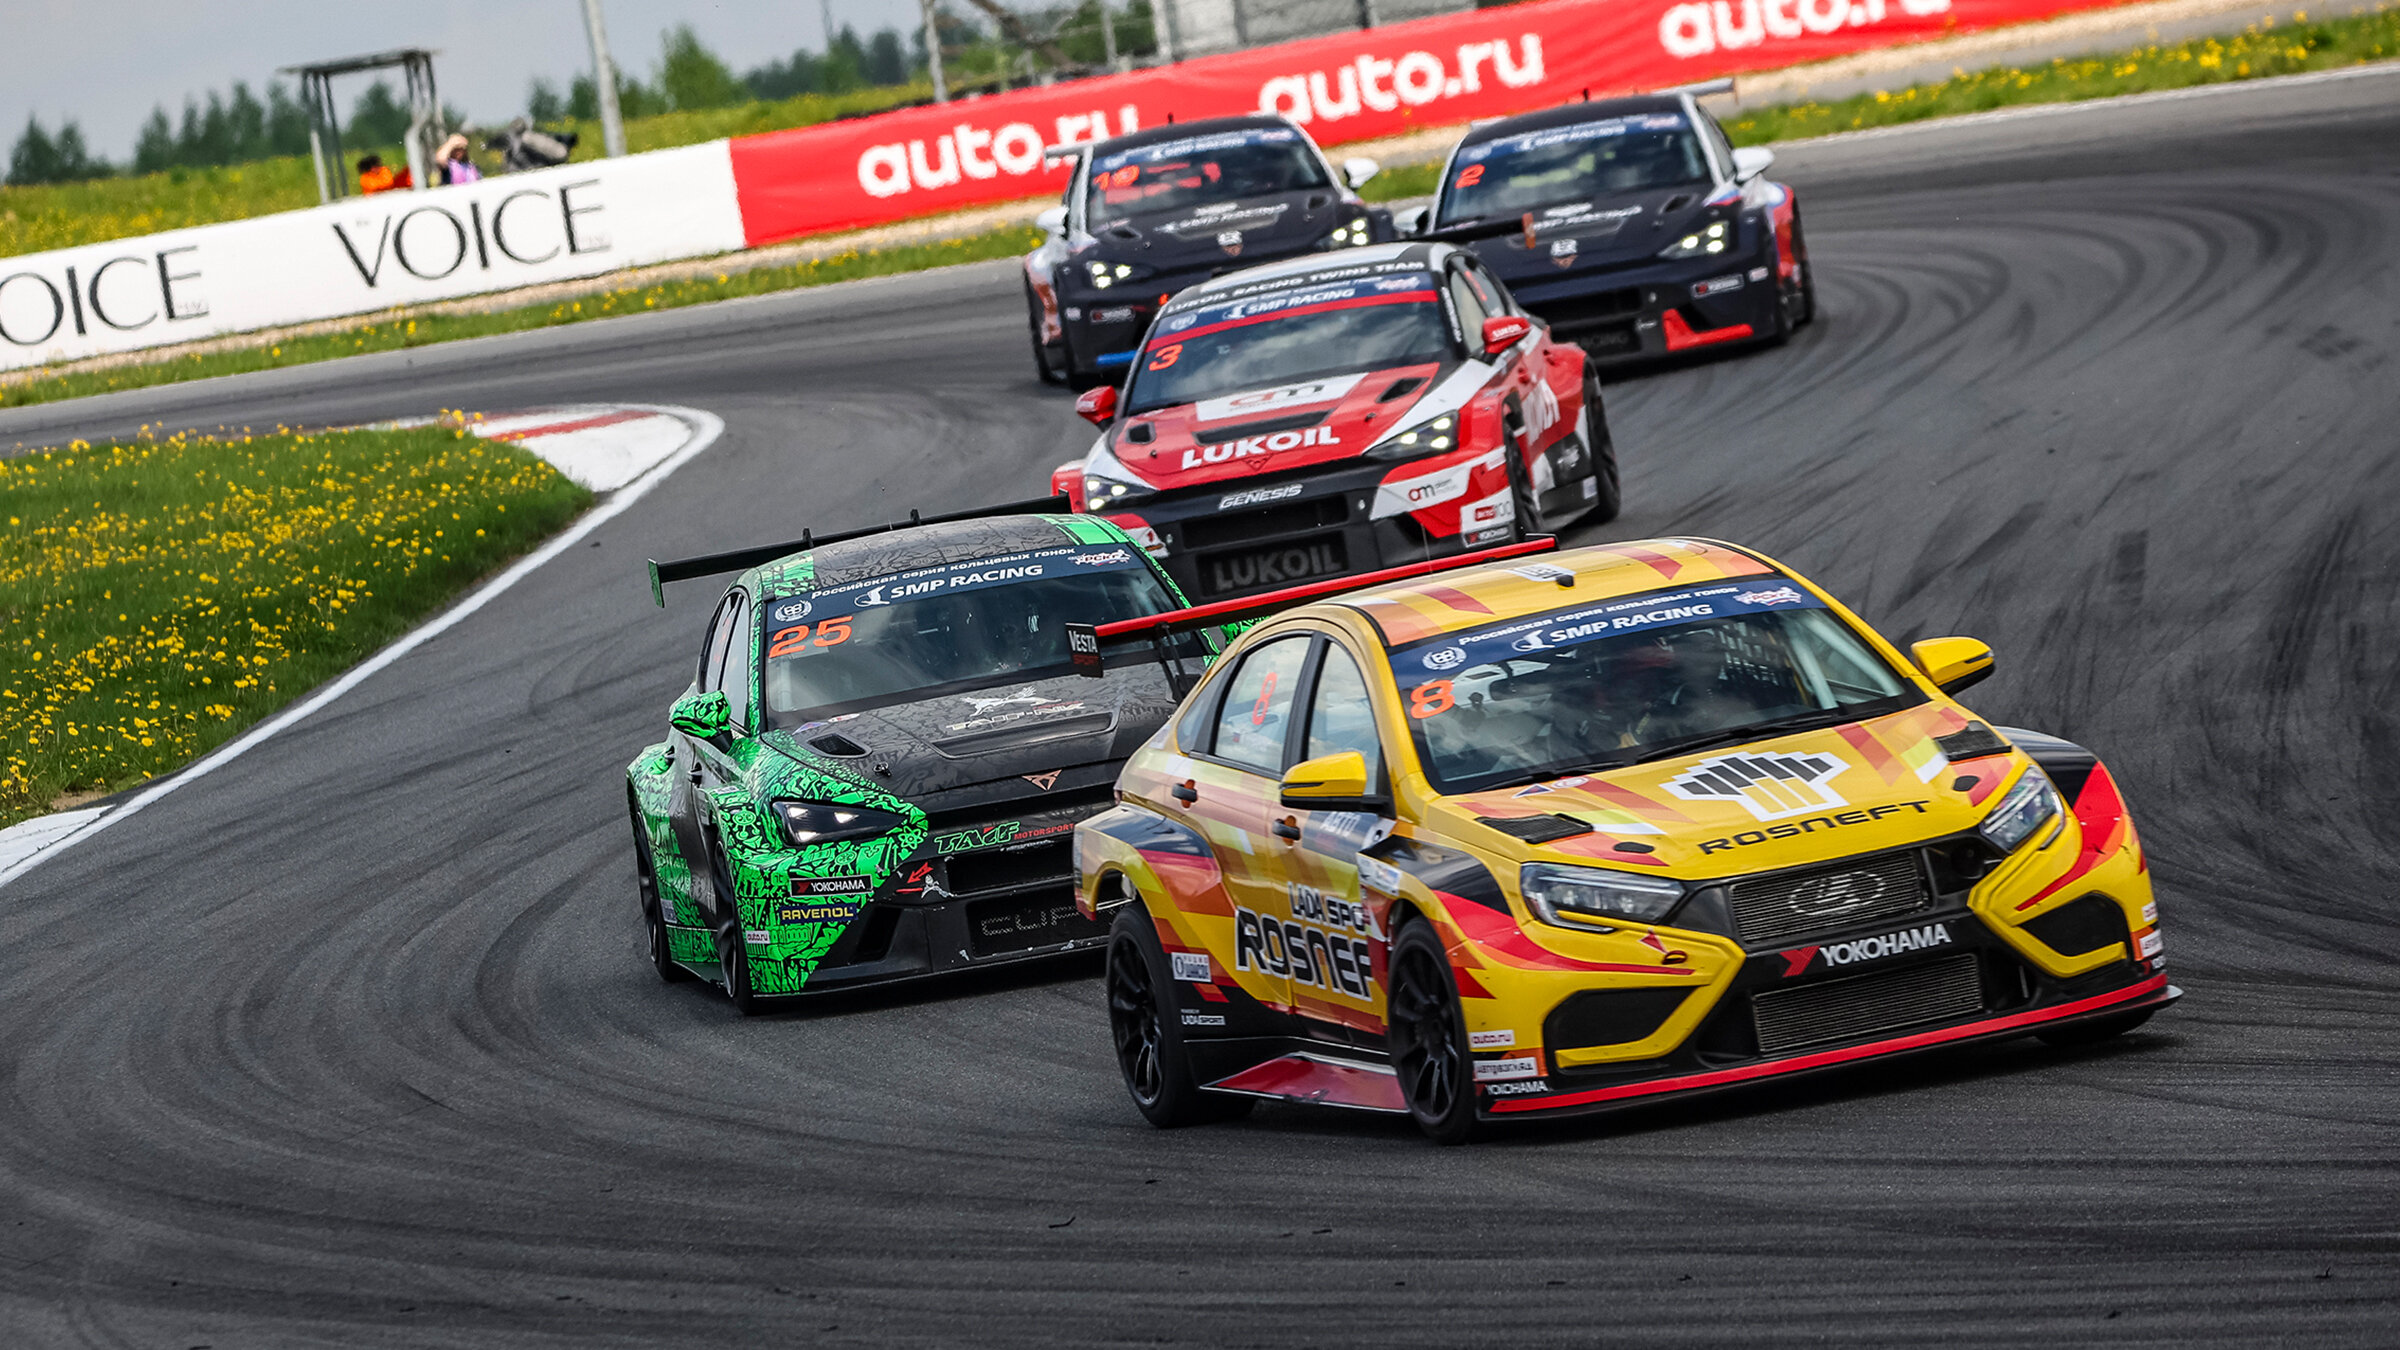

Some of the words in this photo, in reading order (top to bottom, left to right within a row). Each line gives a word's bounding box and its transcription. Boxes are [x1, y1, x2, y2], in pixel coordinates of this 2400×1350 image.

[1658, 0, 1951, 59] auto.
[1259, 33, 1545, 125] auto.ru
[1454, 163, 1486, 189] 2
[331, 179, 612, 288] VOICE
[1167, 292, 1226, 314] LUKOIL
[1231, 276, 1304, 298] RACING
[1309, 266, 1371, 285] TWINS
[1375, 261, 1425, 272] TEAM
[1247, 298, 1288, 316] SMP
[1289, 288, 1357, 308] RACING
[1148, 343, 1184, 371] 3
[1181, 425, 1341, 469] LUKOIL
[1218, 484, 1303, 509] GENESIS
[811, 576, 898, 599] Российская
[902, 567, 946, 580] серия
[950, 553, 1030, 571] кольцевых
[1034, 548, 1076, 558] гонок
[890, 579, 945, 599] SMP
[950, 564, 1044, 588] RACING
[1213, 543, 1345, 593] LUKOIL
[1458, 619, 1553, 646] Российская
[1555, 608, 1604, 623] серия
[1606, 592, 1692, 613] кольцевых
[1693, 586, 1740, 598] гонок
[1549, 618, 1610, 642] SMP
[1612, 603, 1714, 630] RACING
[768, 615, 853, 660] 25
[1067, 630, 1099, 653] VESTA
[1252, 671, 1279, 725] 8
[1410, 679, 1456, 719] 8
[1014, 823, 1076, 841] MOTORSPORT
[1698, 799, 1931, 855] ROSNEFT
[811, 879, 866, 892] YOKOHAMA
[1287, 880, 1327, 925] LADA
[781, 907, 854, 920] RAVENOL
[746, 932, 769, 942] auto.ru
[1819, 923, 1952, 967] YOKOHAMA
[1471, 1032, 1512, 1045] auto.ru
[1485, 1080, 1549, 1096] YOKOHAMA
